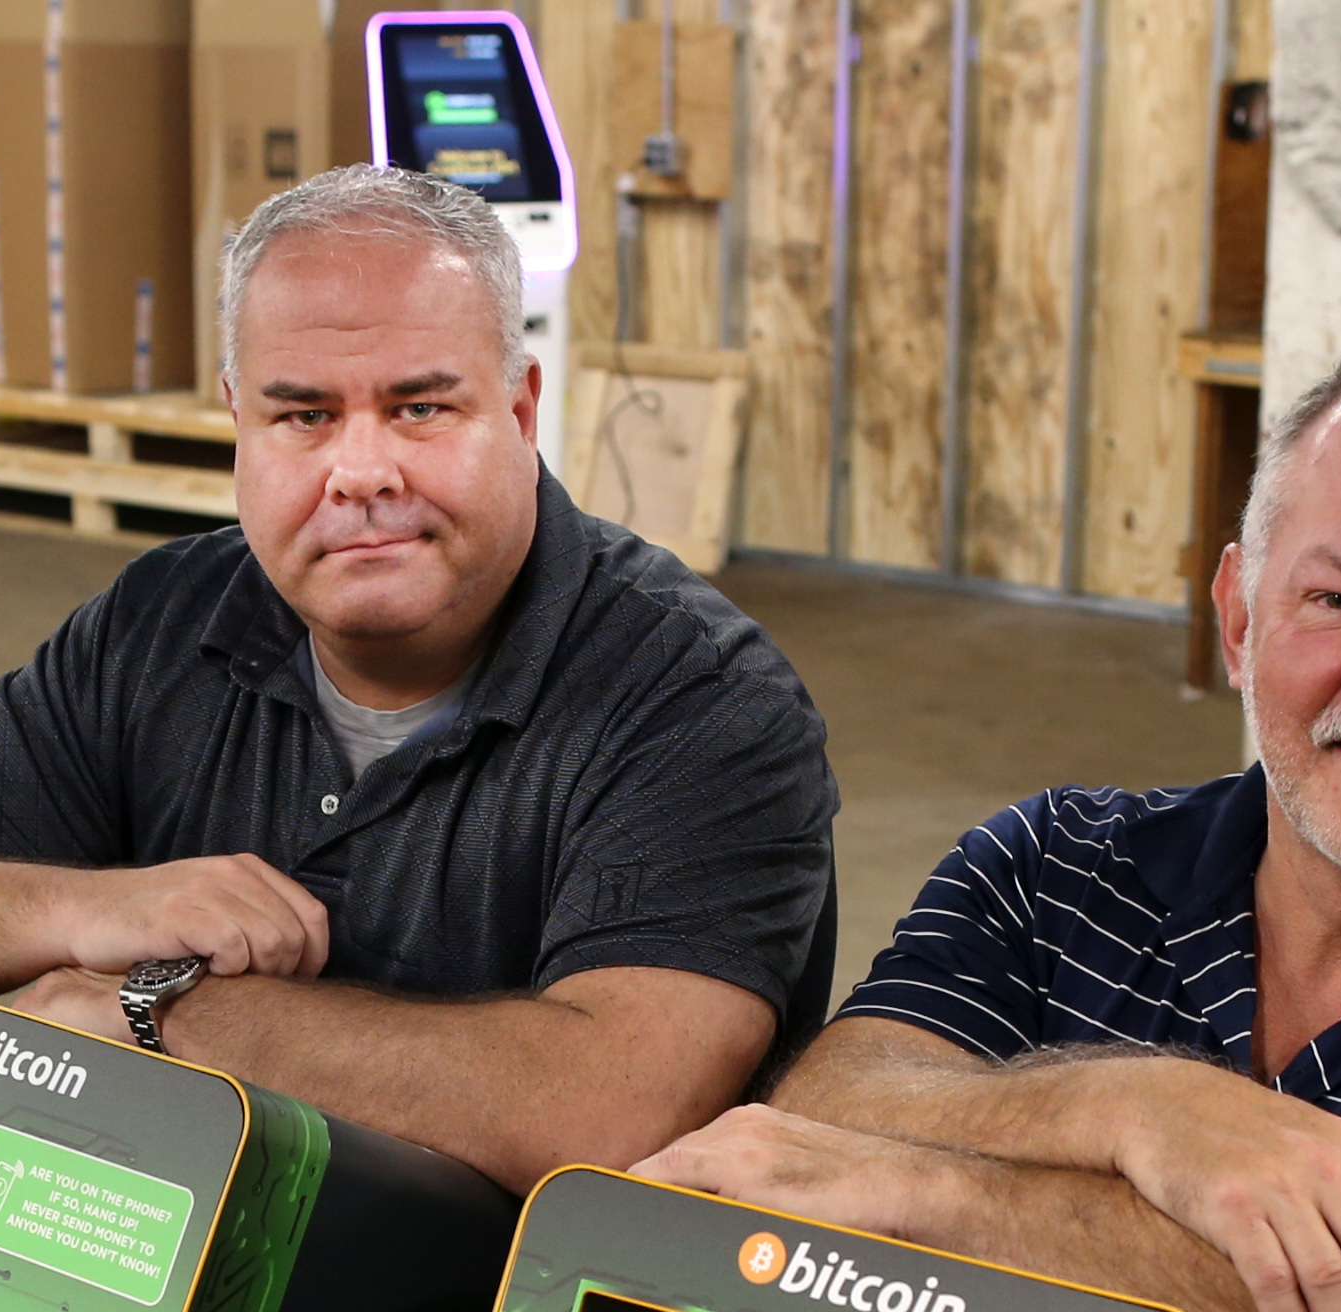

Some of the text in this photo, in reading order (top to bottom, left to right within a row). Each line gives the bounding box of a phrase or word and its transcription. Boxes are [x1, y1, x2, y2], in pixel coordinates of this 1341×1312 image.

[28, 1164, 172, 1223] ARE YOU ON THE PHONE?
[48, 1189, 139, 1232] IF SO, HANG UP!
[5, 1212, 160, 1277] ANYONE YOU DON'T KNOW!
[22, 1199, 155, 1257] NEVER SEND MONEY TO
